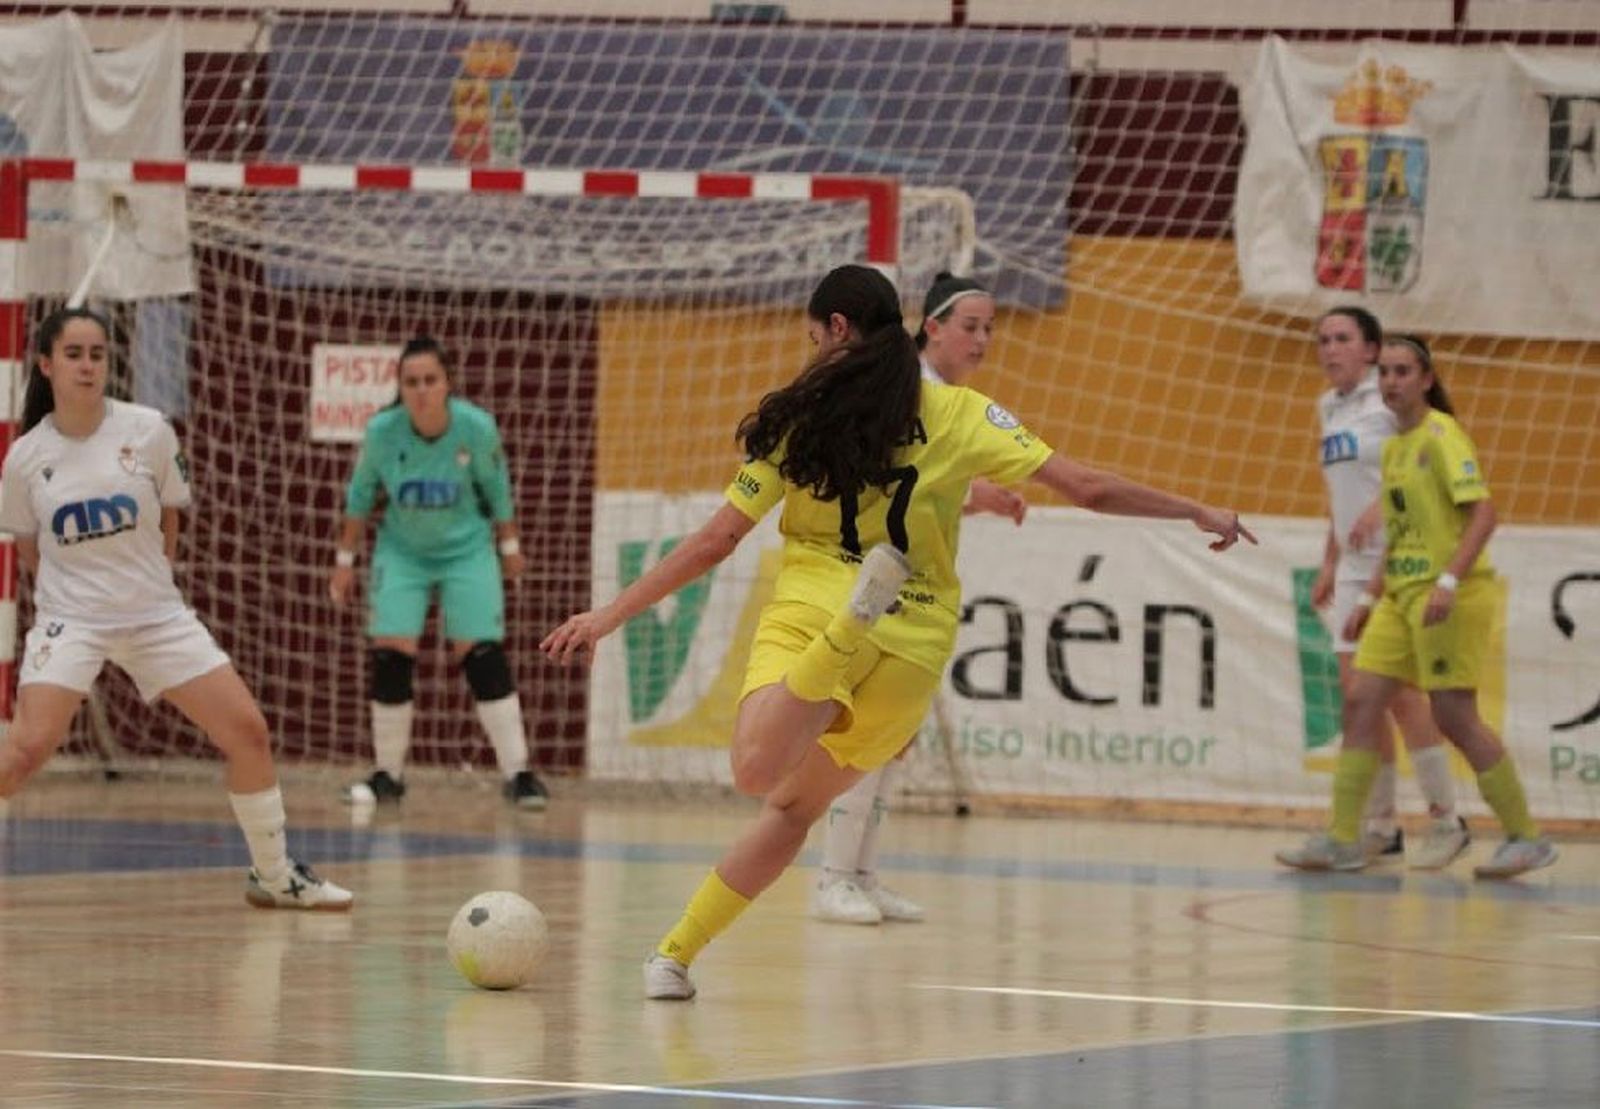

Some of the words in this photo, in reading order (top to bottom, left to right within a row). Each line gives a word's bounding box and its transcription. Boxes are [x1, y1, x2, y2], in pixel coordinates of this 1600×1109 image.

[326, 356, 399, 384] PISTA
[838, 463, 918, 556] 17
[950, 555, 1215, 708] aén
[1046, 719, 1217, 768] interior
